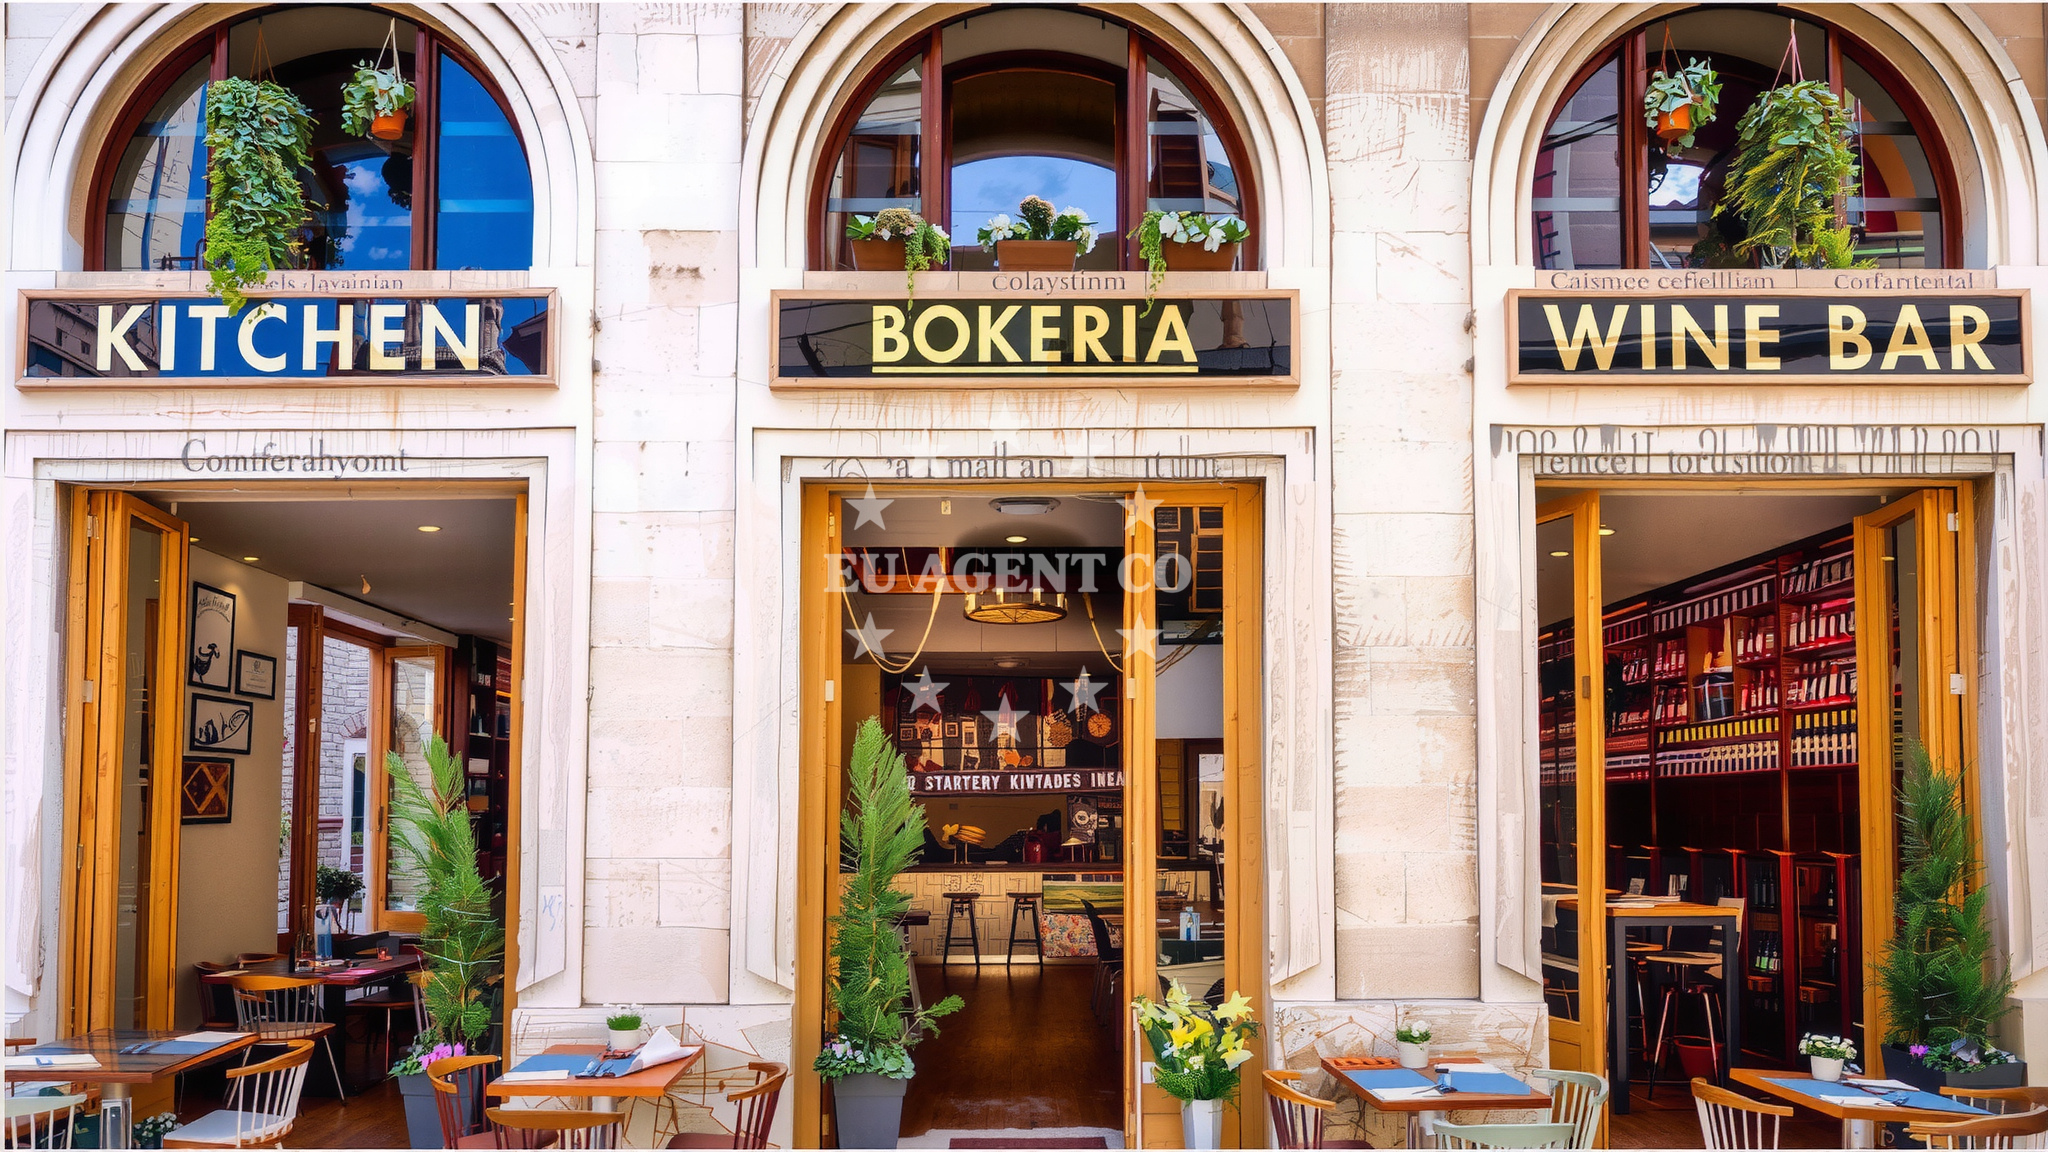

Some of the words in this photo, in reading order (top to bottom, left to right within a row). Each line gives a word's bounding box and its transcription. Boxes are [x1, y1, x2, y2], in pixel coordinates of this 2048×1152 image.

[96, 304, 480, 372] KITCHEN
[872, 303, 1199, 364] BOKERIA
[1543, 304, 1781, 371] WINE
[1828, 304, 1996, 371] BAR
